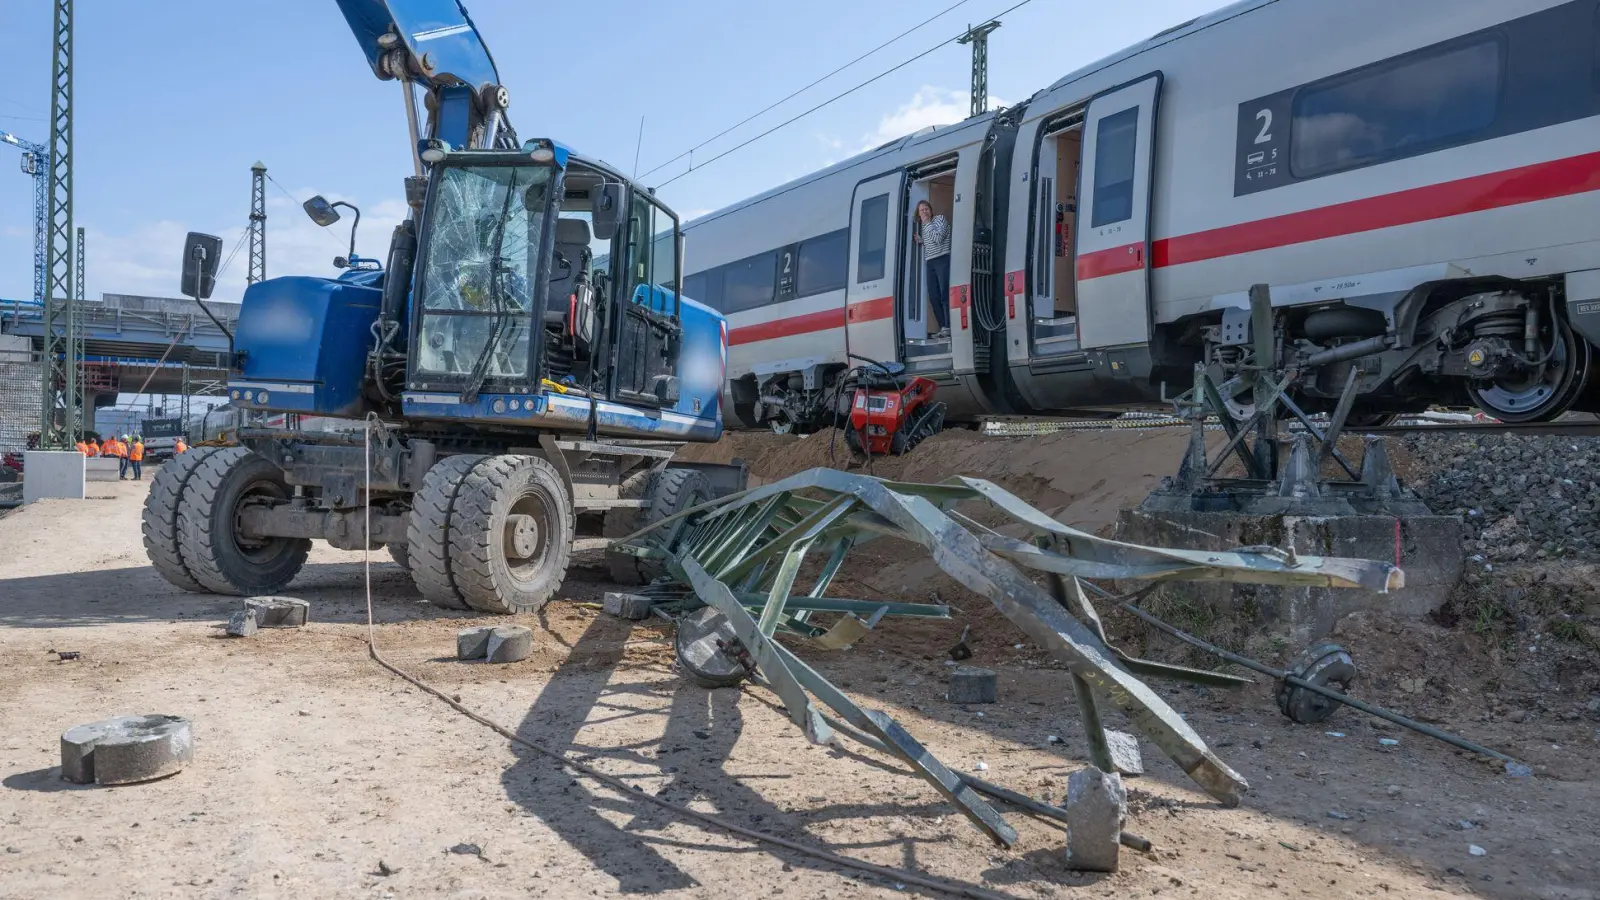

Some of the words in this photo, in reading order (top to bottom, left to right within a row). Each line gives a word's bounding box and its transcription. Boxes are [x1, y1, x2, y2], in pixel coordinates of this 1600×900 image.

[1254, 108, 1273, 145] 2
[1271, 148, 1278, 159] 5
[784, 252, 791, 274] 2
